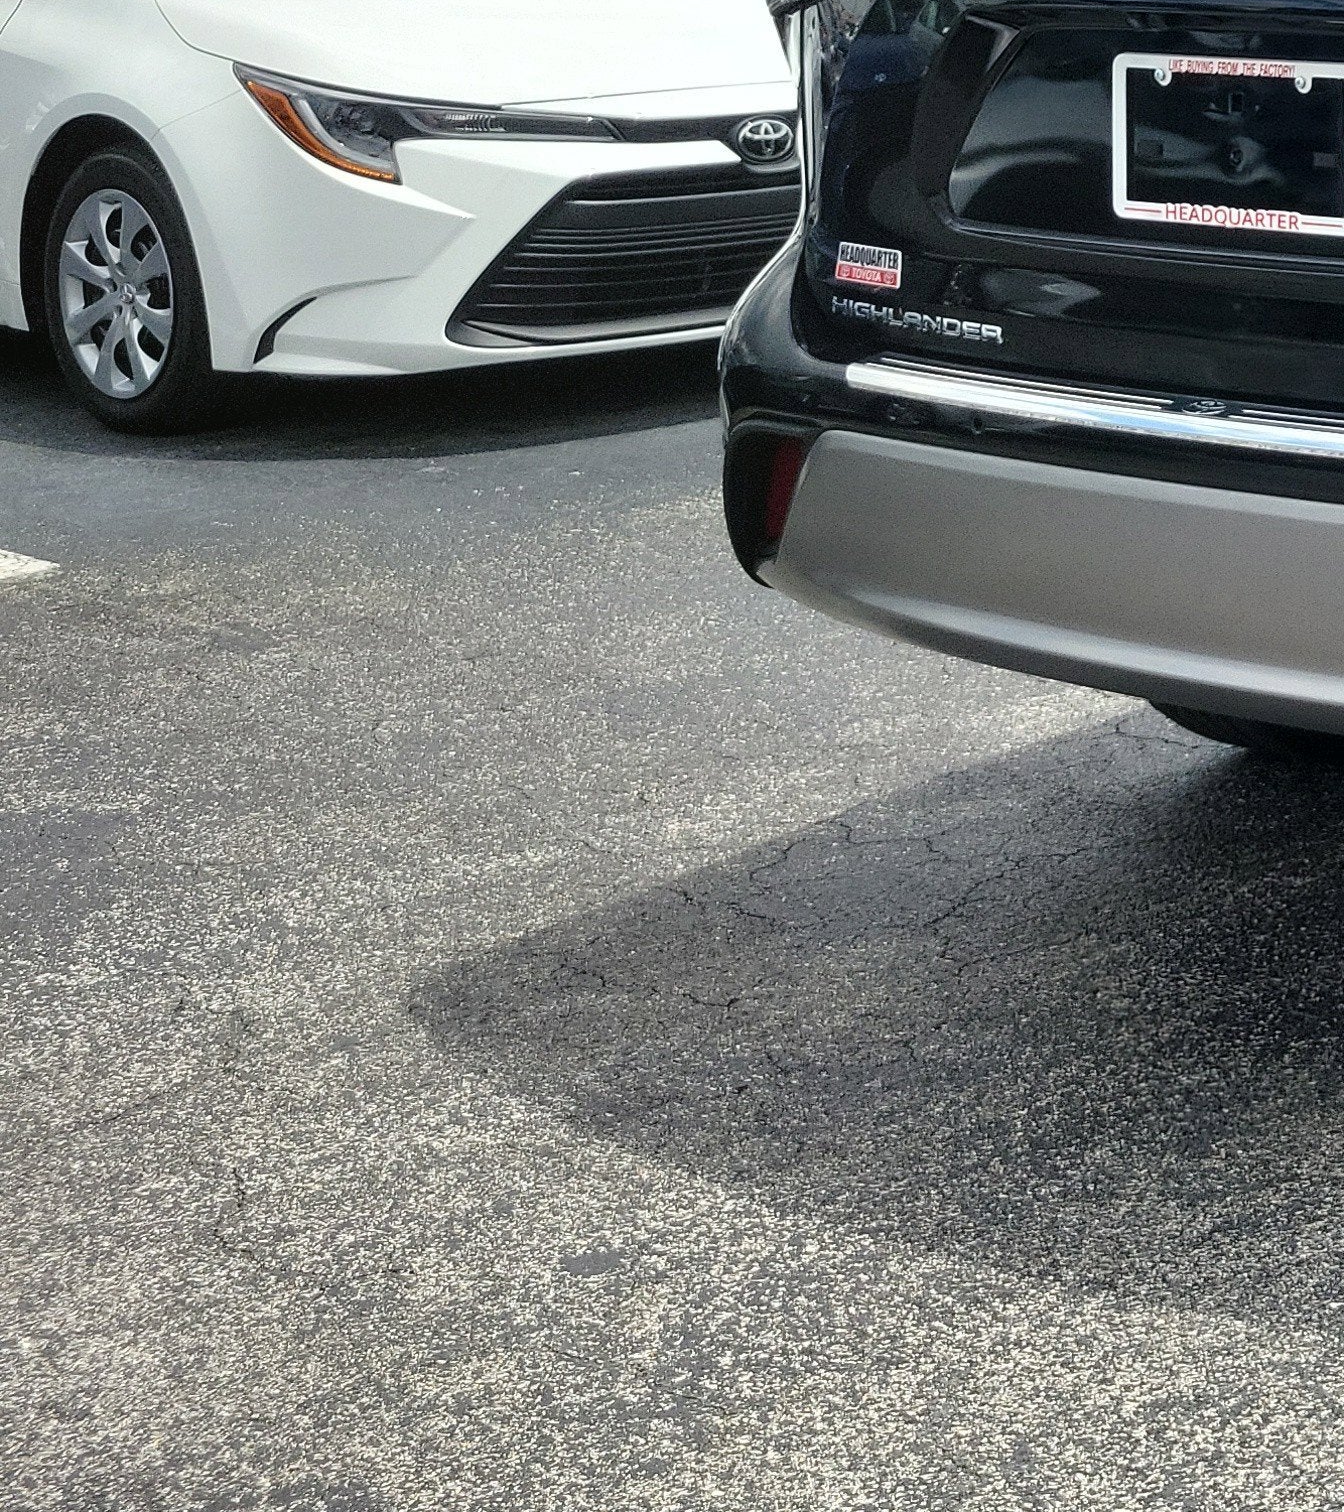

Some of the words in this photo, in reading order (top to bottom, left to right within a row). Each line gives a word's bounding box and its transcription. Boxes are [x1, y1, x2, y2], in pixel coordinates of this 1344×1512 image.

[1169, 59, 1183, 71] LIKE
[1187, 60, 1214, 73] BUYING
[1218, 61, 1239, 75] FROM
[1242, 62, 1256, 76] THE
[1165, 203, 1299, 231] HEADQUARTER
[840, 243, 899, 271] HEADQUARTER
[851, 266, 882, 283] TOYOTA
[832, 295, 1004, 344] HIGHLANDER
